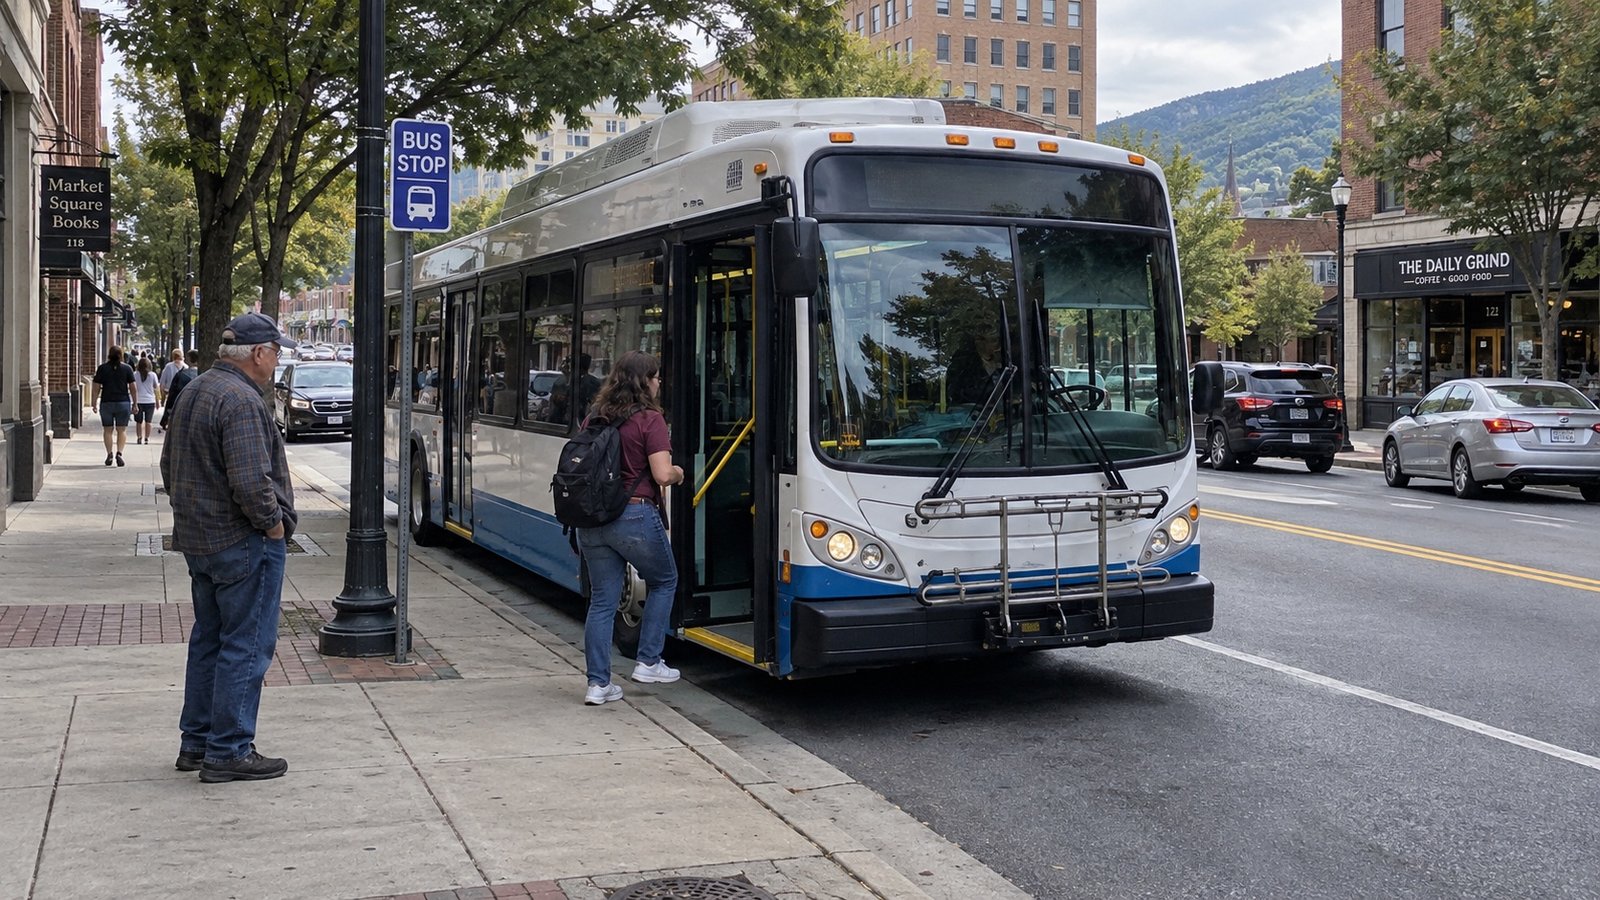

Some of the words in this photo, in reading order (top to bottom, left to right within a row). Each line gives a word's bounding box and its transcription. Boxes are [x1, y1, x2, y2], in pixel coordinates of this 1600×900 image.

[403, 131, 442, 151] BUS
[398, 154, 447, 174] STOP
[48, 178, 105, 193] Market
[49, 196, 103, 213] Square
[52, 215, 100, 229] Books
[67, 239, 85, 247] 118
[1399, 260, 1422, 275] THE
[1426, 256, 1463, 273] DAILY
[1465, 252, 1510, 270] GRIND
[1448, 274, 1470, 283] GOOD
[1471, 273, 1492, 281] FOOD
